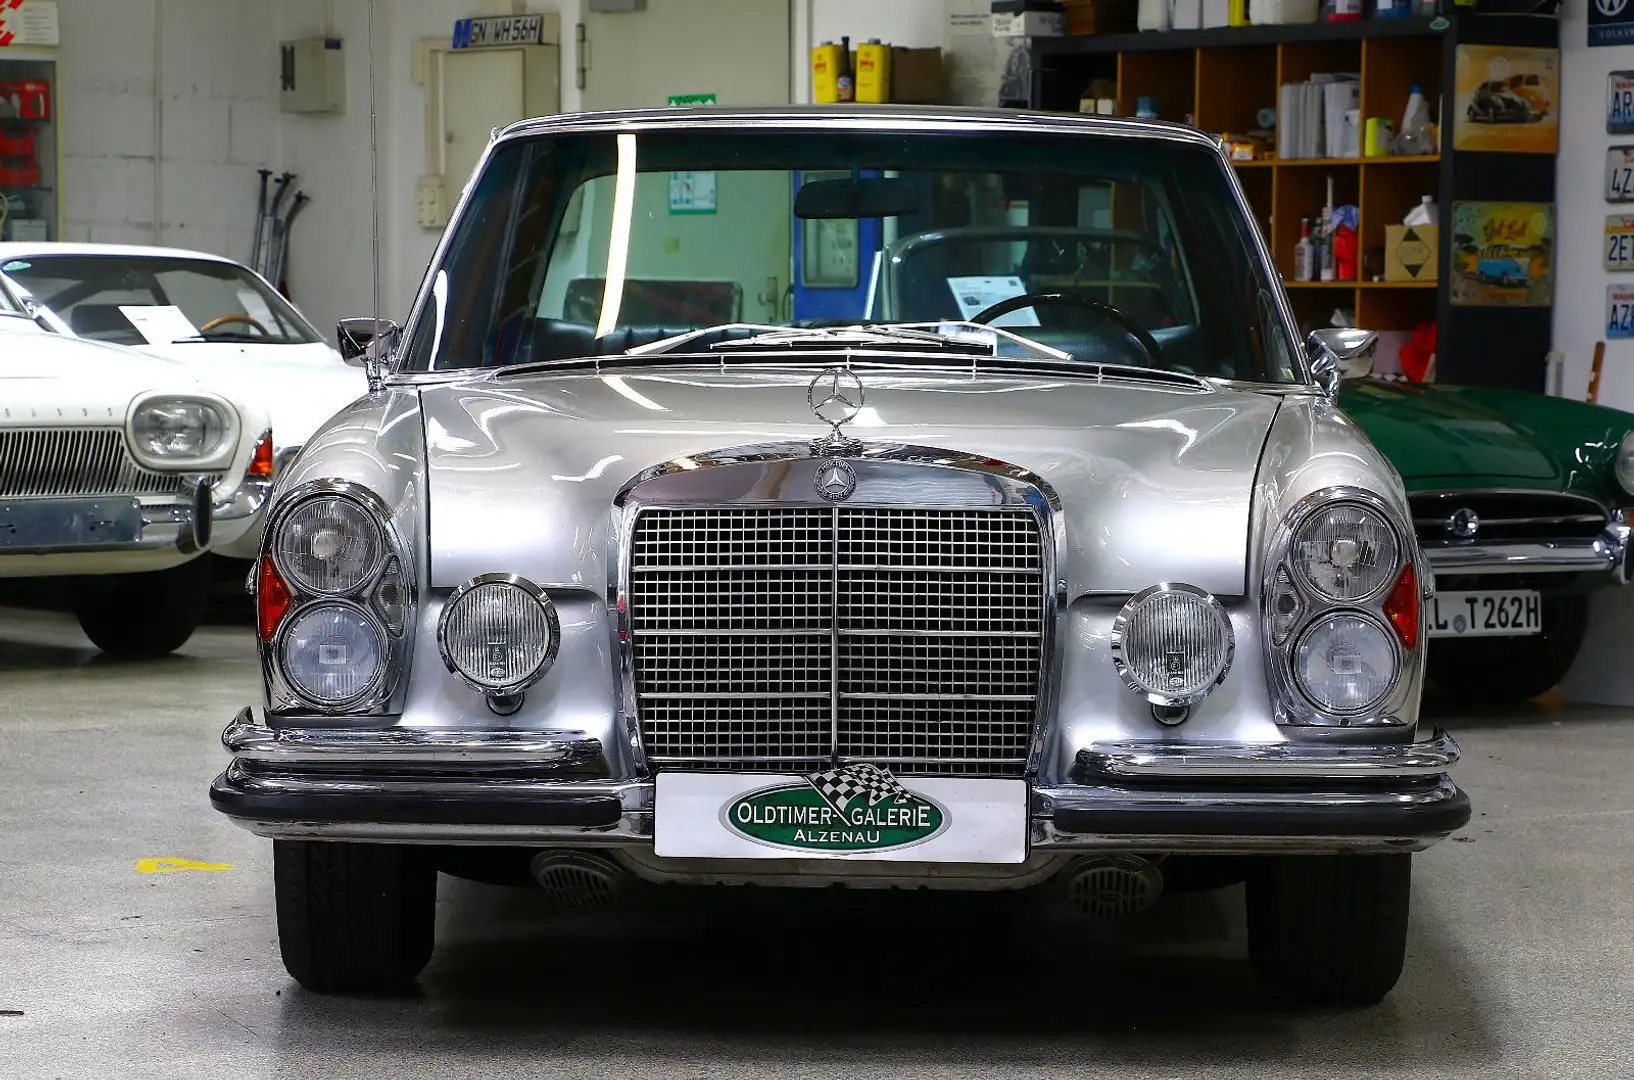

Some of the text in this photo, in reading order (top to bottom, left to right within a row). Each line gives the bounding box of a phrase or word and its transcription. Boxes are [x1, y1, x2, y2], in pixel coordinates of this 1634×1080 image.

[1611, 168, 1634, 193] 4Z
[1428, 596, 1539, 630] L T262H
[737, 802, 931, 827] OLDTIMER- GALERIE
[793, 828, 880, 843] ALZENAU
